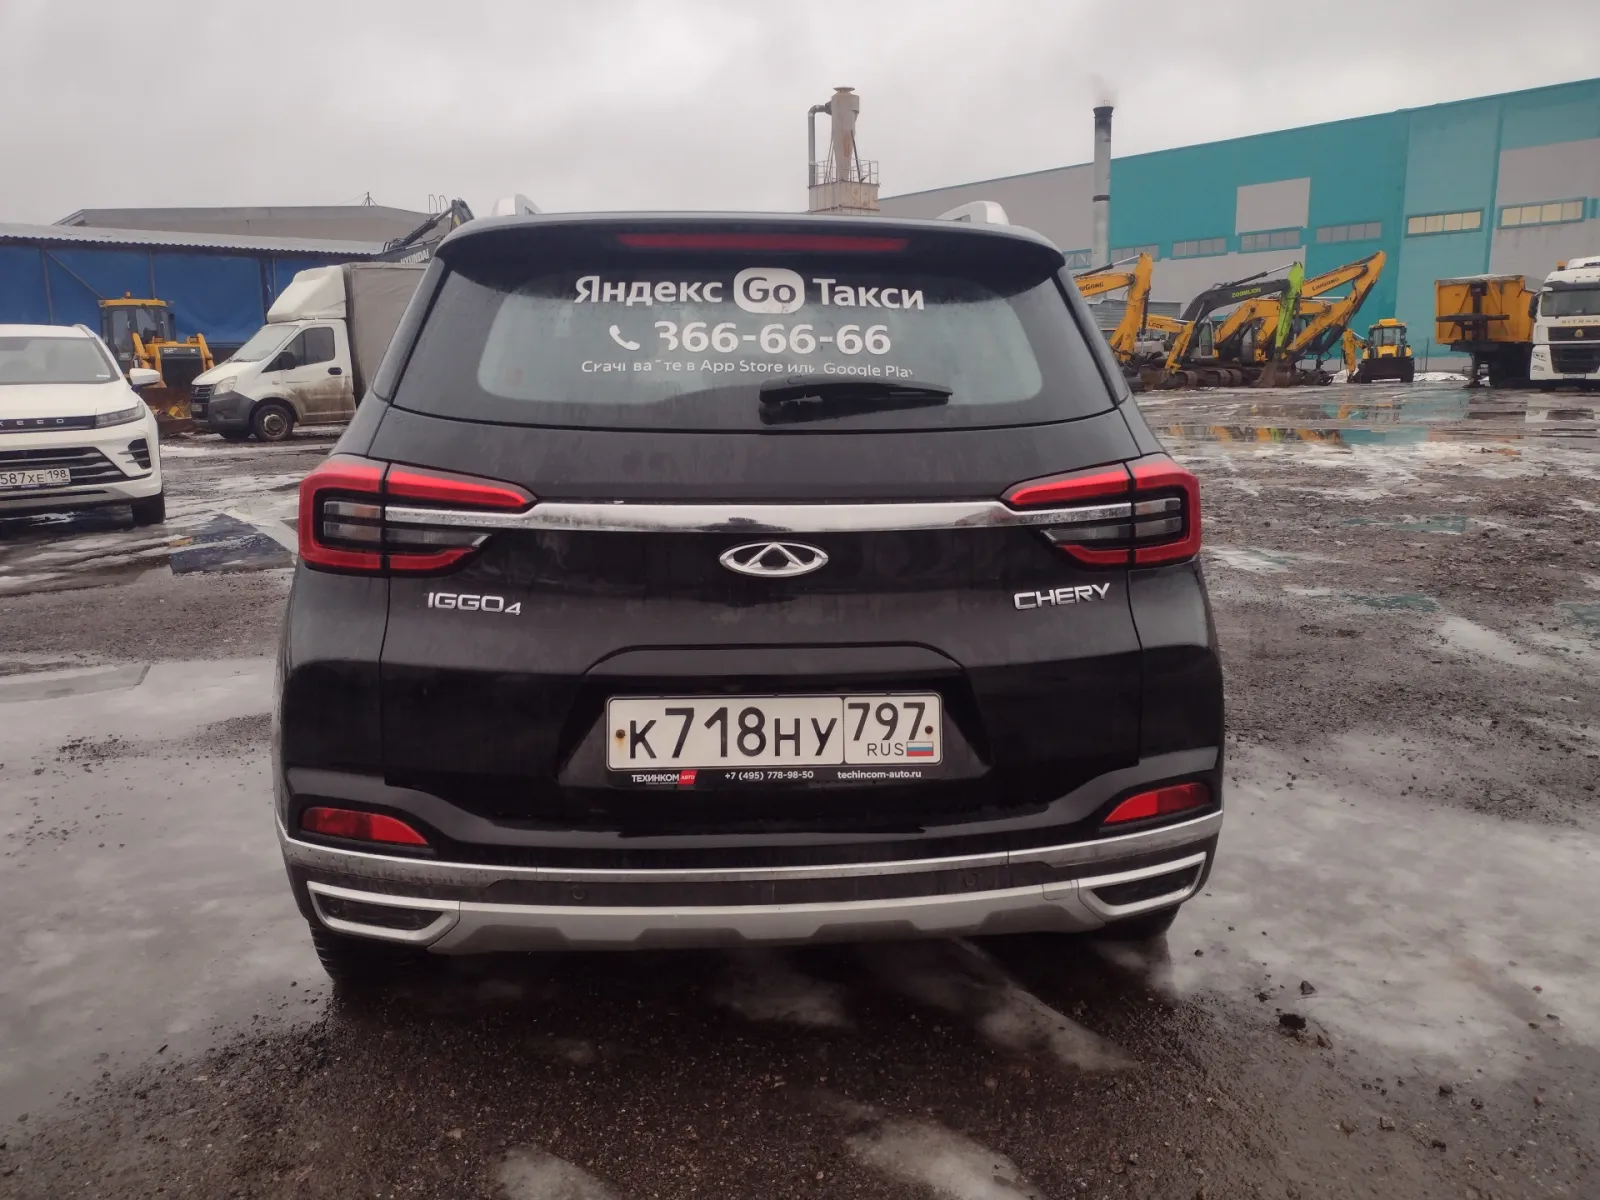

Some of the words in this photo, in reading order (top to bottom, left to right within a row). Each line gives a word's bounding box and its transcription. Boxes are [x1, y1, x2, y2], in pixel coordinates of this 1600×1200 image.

[574, 275, 723, 307] Яндекс
[742, 276, 797, 303] Go
[812, 278, 925, 311] Такси
[654, 320, 891, 355] 366-66-66
[687, 361, 696, 371] в
[700, 360, 735, 374] App
[739, 360, 783, 372] Store
[823, 362, 881, 377] Google
[885, 365, 914, 378] Pla
[47, 469, 67, 479] 198
[1013, 582, 1111, 610] CHERY
[848, 702, 926, 741] 797
[867, 742, 904, 756] RUS
[631, 773, 680, 783] ТЕХИНКОМ
[724, 771, 737, 780] +7
[738, 771, 765, 780] (495)
[767, 770, 814, 779] 778-98-50
[837, 770, 922, 779] techincom-auto.ru
